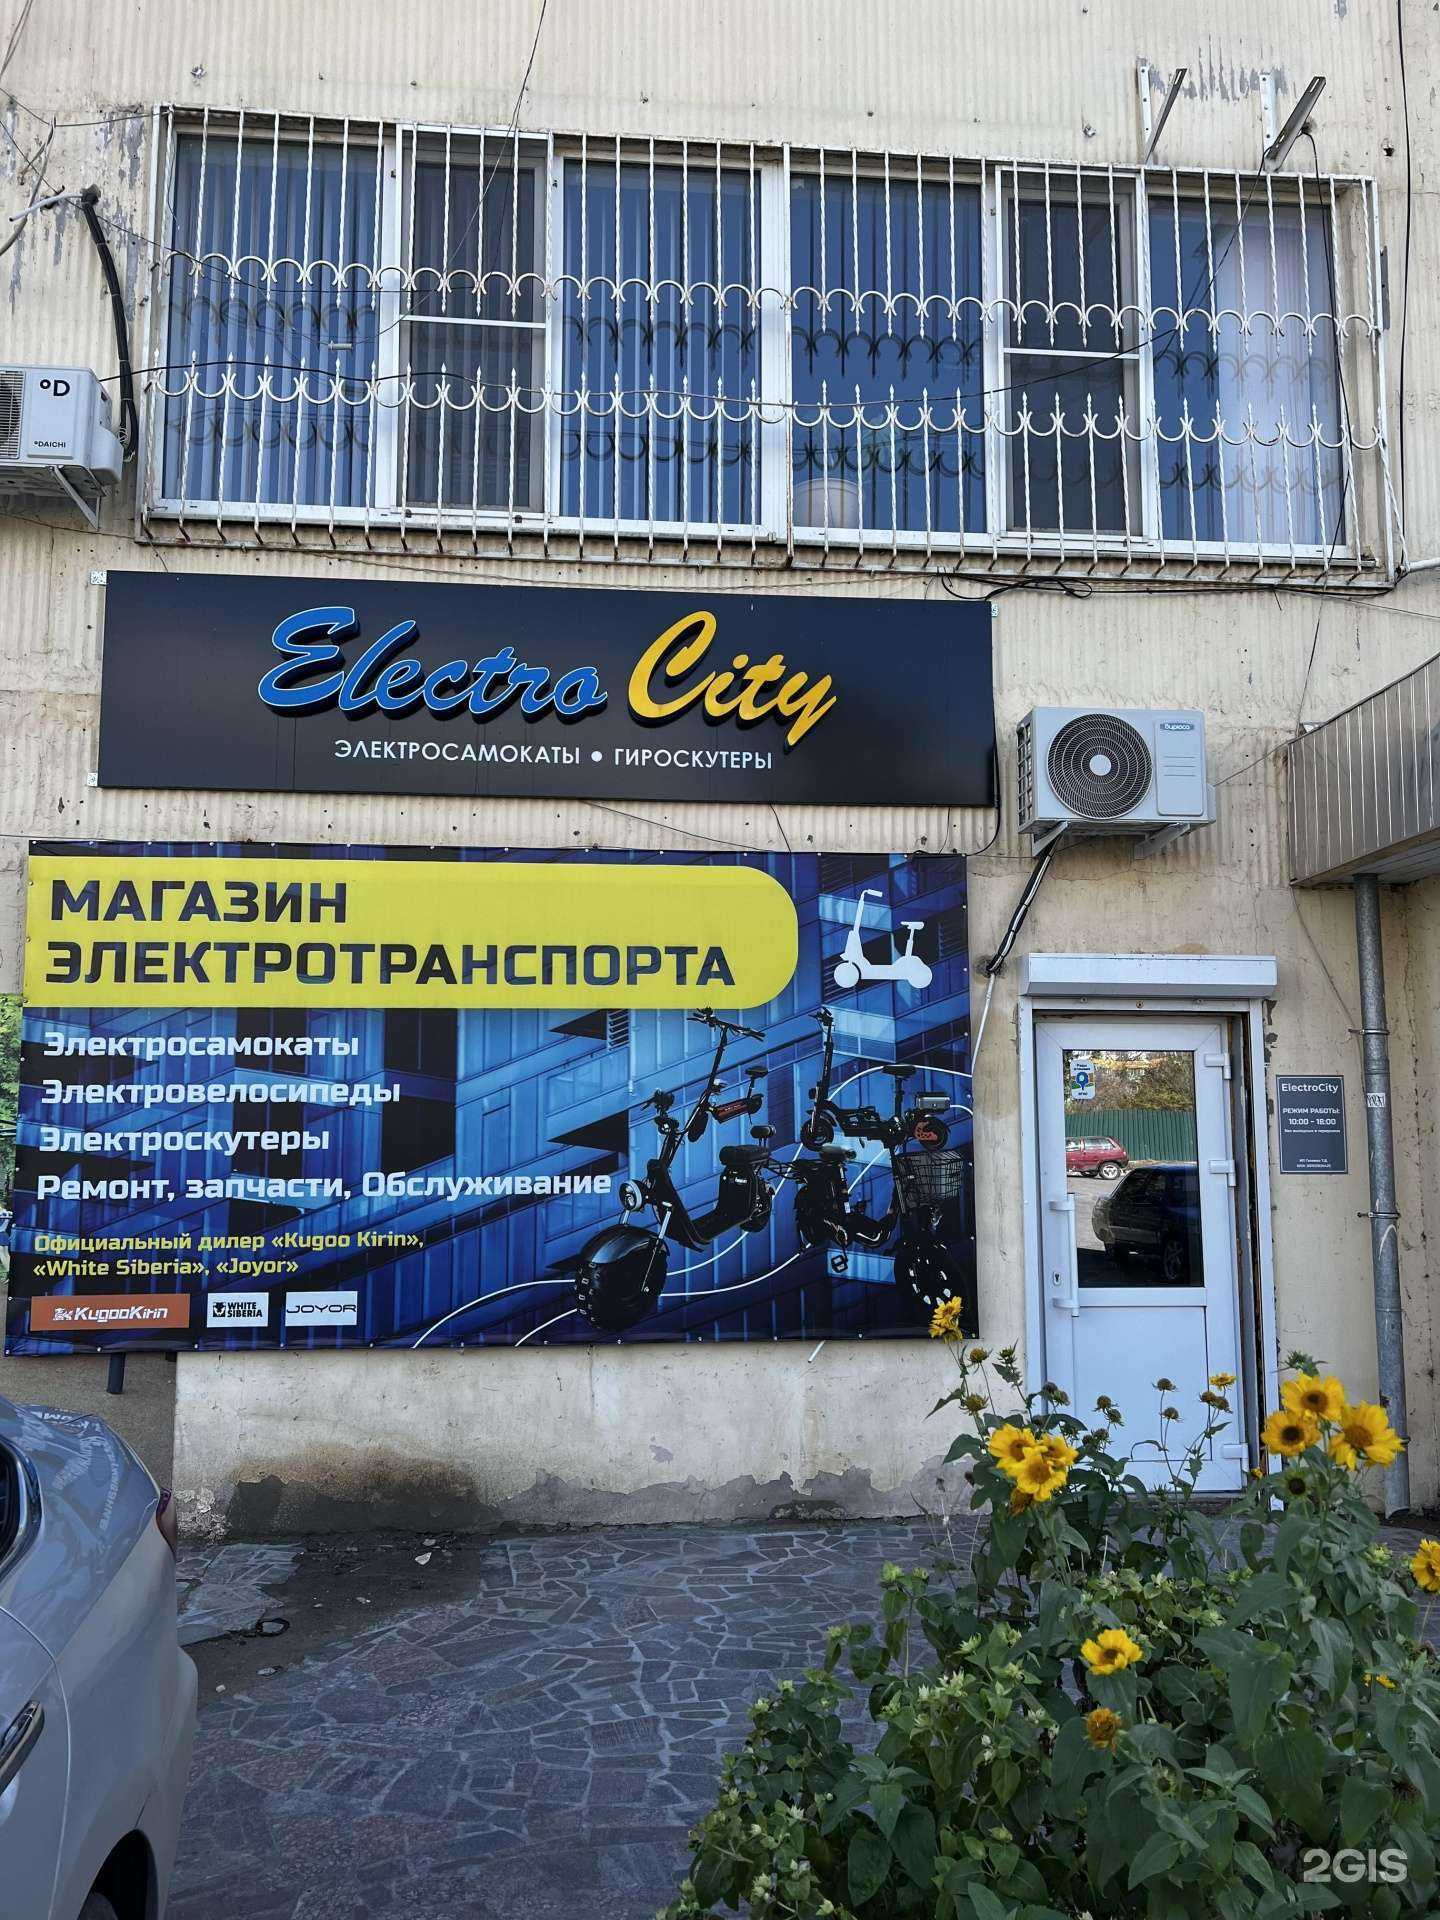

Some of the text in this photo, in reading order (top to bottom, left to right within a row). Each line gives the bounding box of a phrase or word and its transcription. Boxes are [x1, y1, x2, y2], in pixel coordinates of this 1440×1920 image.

[258, 606, 837, 746] Electro City
[333, 740, 773, 769] ЭЛЕКТРОСАМОКАТЫ ГИРОСКУТЕРЫ
[51, 879, 347, 923] МАГАЗИН
[45, 941, 736, 986] ЭЛЕКТРОТРАНСПОРТА
[43, 1031, 359, 1061] Электросамокаты
[41, 1079, 400, 1108] Электровелосипеды
[1281, 1083, 1339, 1094] ElectroCity
[38, 1127, 330, 1156] Электроскутеры
[37, 1172, 611, 1202] Ремонт, запчасти, Обслуживание
[34, 1231, 424, 1254] Официальный дилер «Kugoo Kirin»,
[33, 1257, 299, 1277] «White Siberia», «Joyor»
[227, 1302, 257, 1310] WHITE
[227, 1309, 263, 1318] SIBERIA
[286, 1304, 357, 1314] JOYOR
